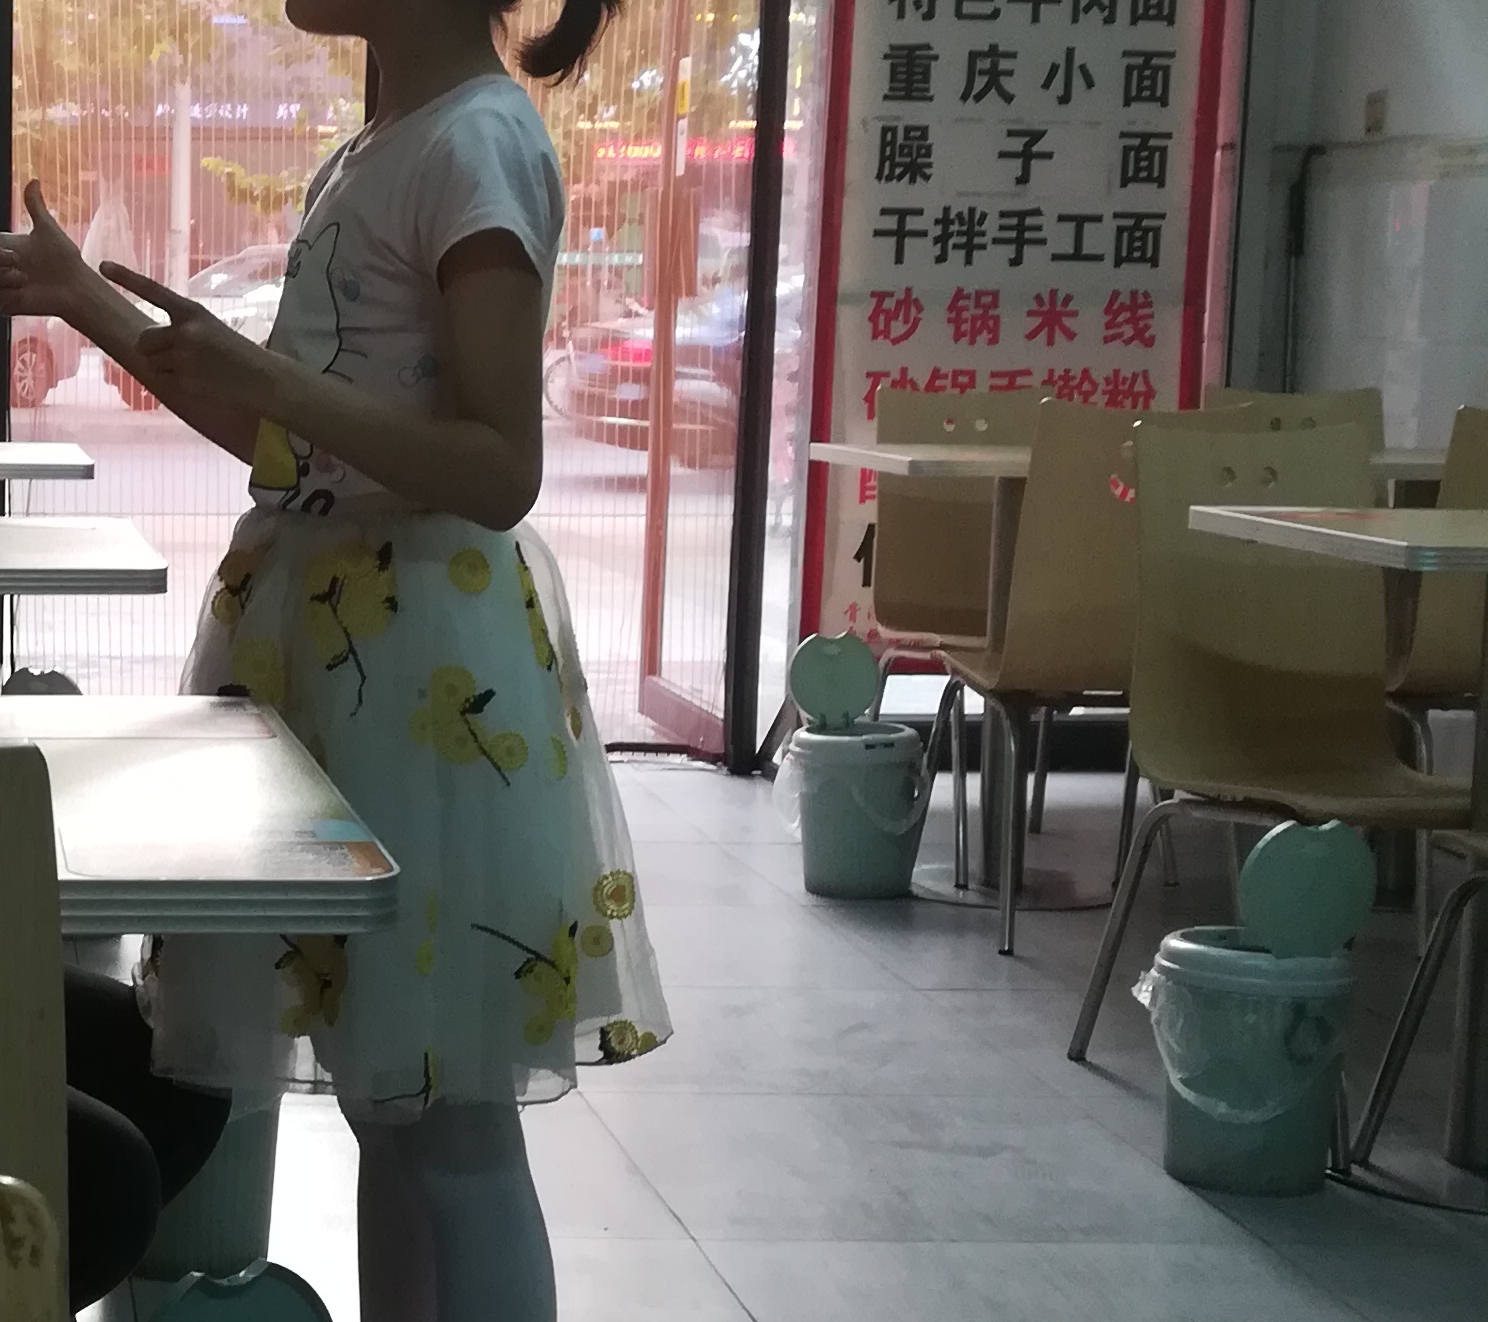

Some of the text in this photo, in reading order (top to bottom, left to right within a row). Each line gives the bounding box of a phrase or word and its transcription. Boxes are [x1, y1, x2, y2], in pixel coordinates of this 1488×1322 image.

[881, 42, 1176, 109] 重庆小面
[876, 125, 1173, 189] 臊子面
[872, 206, 1167, 270] 干拌手工面
[868, 286, 1157, 350] 砂锅米线
